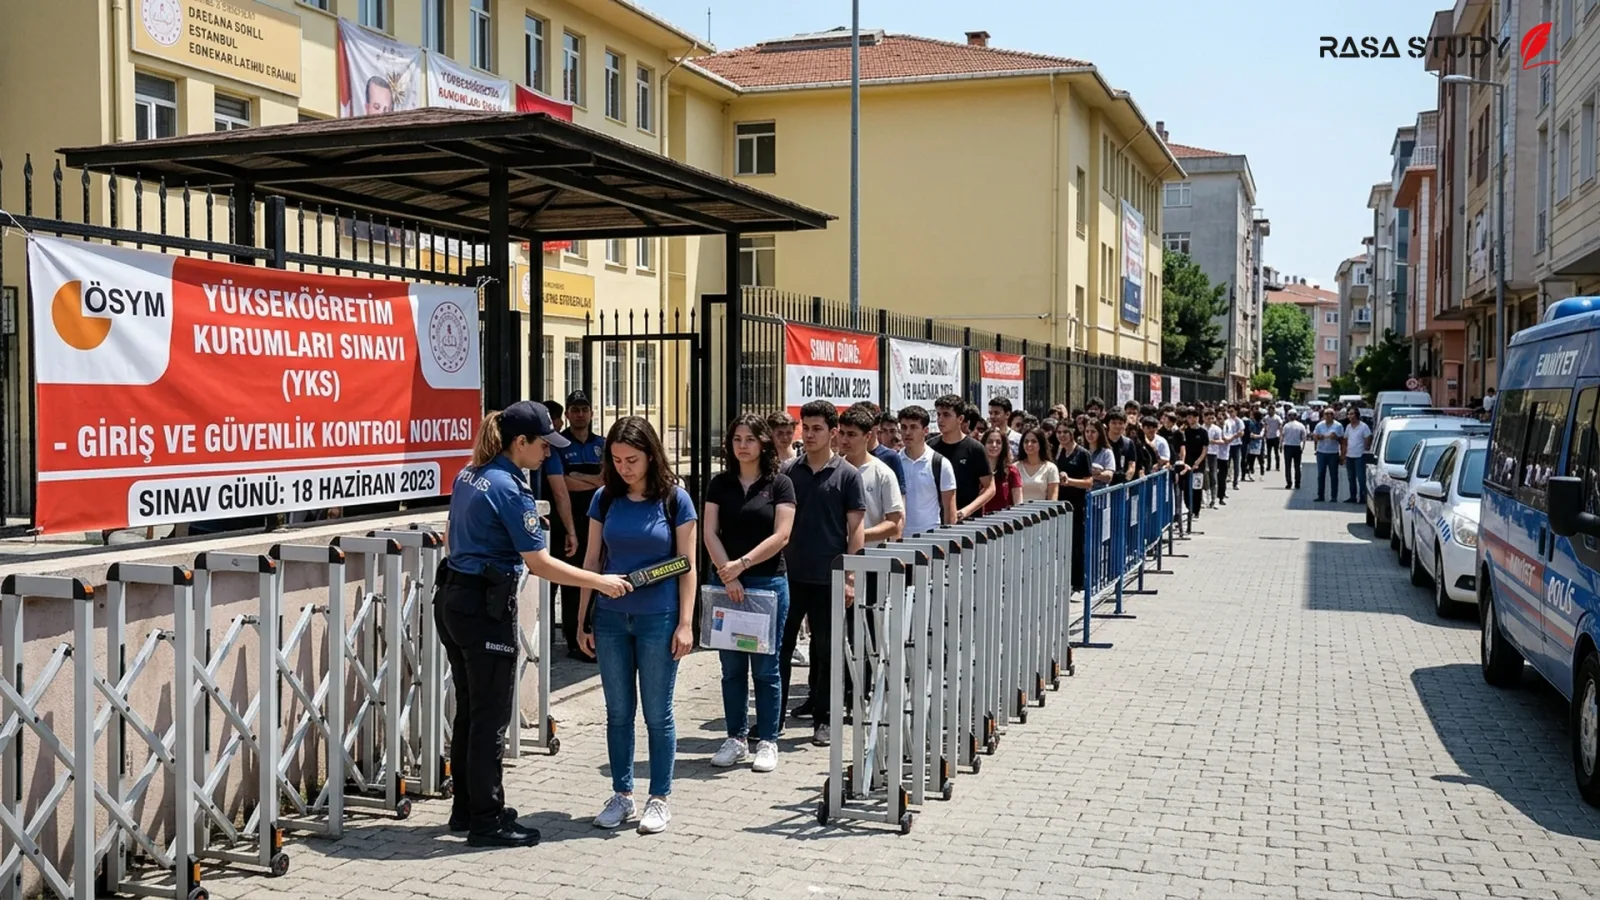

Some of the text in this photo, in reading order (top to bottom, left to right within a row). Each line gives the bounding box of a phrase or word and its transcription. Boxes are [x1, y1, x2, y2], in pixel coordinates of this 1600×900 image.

[188, 24, 239, 49] ESTANBUL
[84, 280, 166, 318] ÖSYM
[202, 278, 394, 326] YÜKSEKÖĞRETİM
[193, 324, 406, 361] KURUMLARI SINAVI
[281, 369, 342, 403] (YKS)
[77, 417, 155, 464] GİRİŞ
[163, 424, 197, 454] VE
[204, 415, 316, 453] GÜVENLİK
[321, 419, 406, 448] KONTROL
[410, 417, 472, 443] NOKTASI
[139, 469, 436, 517] SINAV GÜNÜ: 18 HAZİRAN 2023
